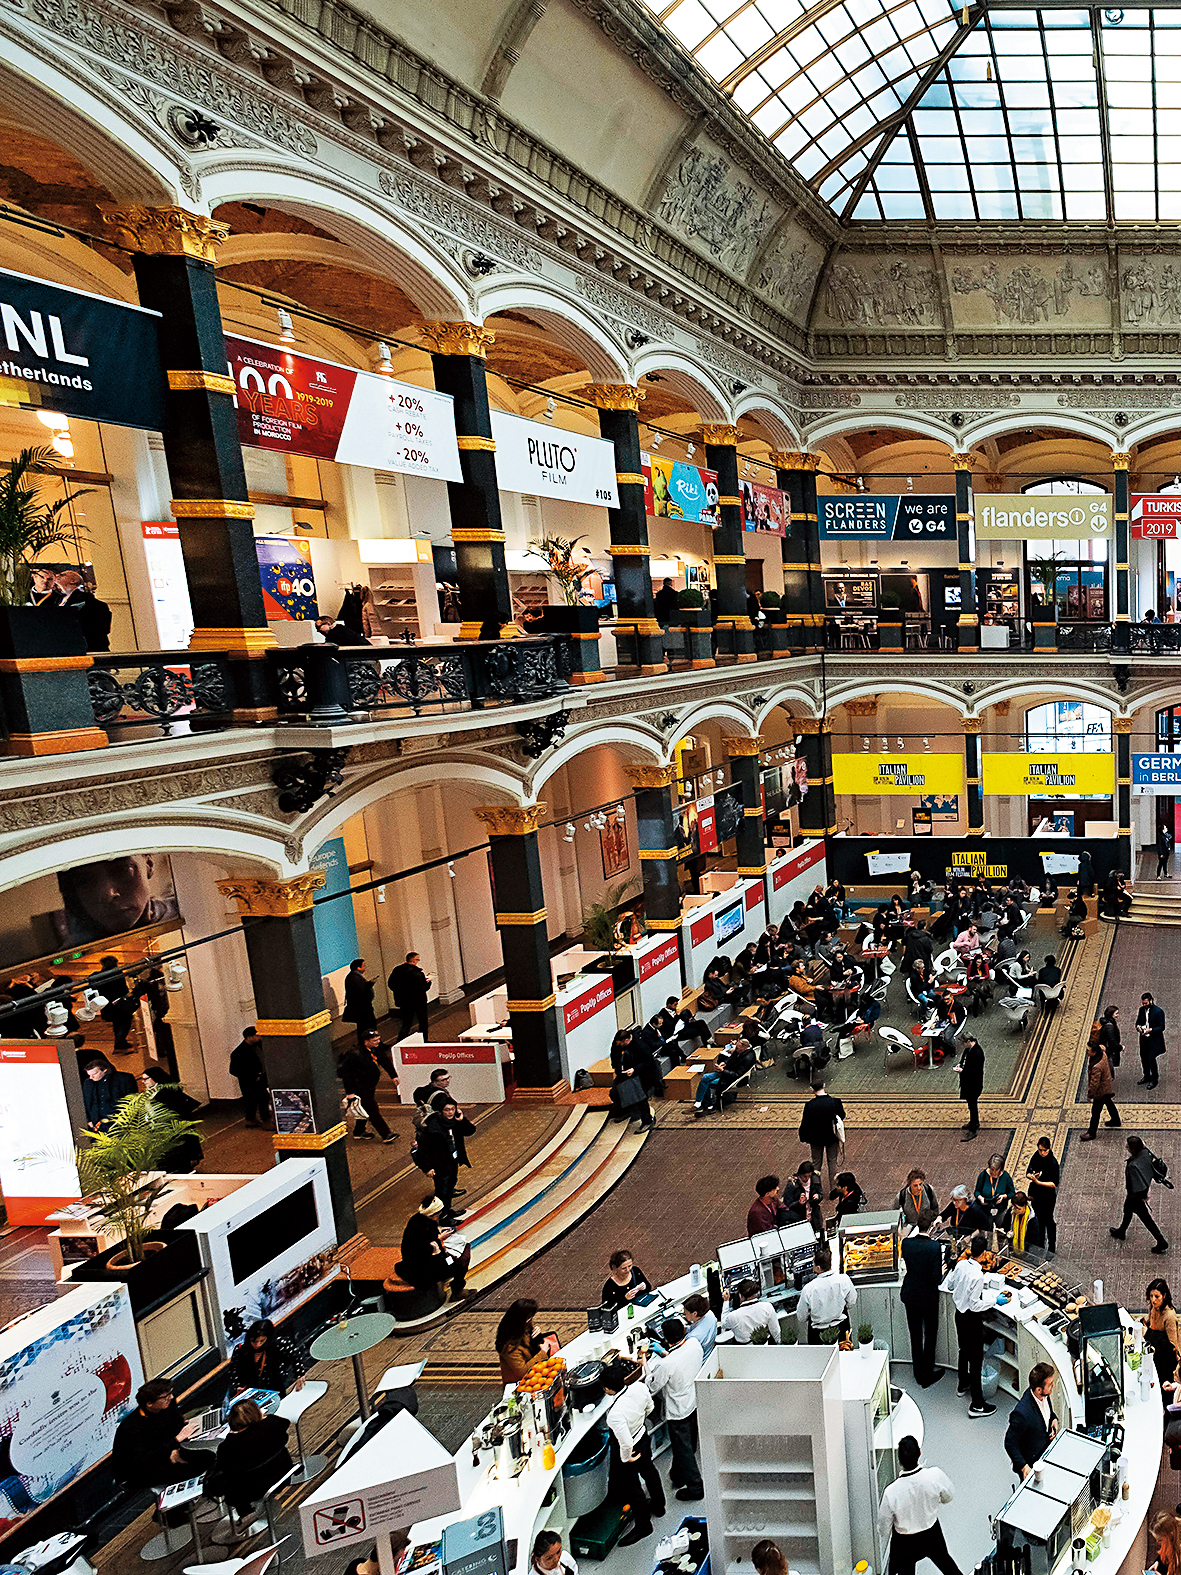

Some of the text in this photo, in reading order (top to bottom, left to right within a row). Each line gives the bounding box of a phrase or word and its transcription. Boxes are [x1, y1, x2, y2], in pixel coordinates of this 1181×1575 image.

[0, 303, 90, 367] NL
[243, 357, 285, 373] CELEBRATION
[285, 366, 294, 375] OF
[0, 361, 93, 391] therlands
[296, 391, 334, 408] 1919-2019
[398, 394, 424, 413] 20%
[242, 388, 319, 426] YEARS
[252, 413, 303, 430] OF FOREIGN FILM
[252, 421, 292, 434] PRODUCTION
[261, 430, 292, 441] MOROCCO
[404, 422, 424, 438] 0%
[403, 447, 429, 464] 20%
[527, 437, 576, 473] PLUTO
[387, 459, 406, 468] VALUE
[541, 471, 567, 485] FILM
[676, 479, 699, 495] Riki
[595, 489, 612, 501] #105
[825, 502, 886, 518] SCREEN
[904, 504, 948, 514] we are
[1089, 502, 1108, 513] G4
[981, 506, 1069, 528] flanders
[825, 520, 887, 529] FLANDERS
[926, 520, 946, 532] G4
[1146, 523, 1174, 535] 2019
[280, 578, 315, 597] ifp 40
[879, 764, 906, 775] ITALIAN
[1029, 764, 1057, 775] ITALIAN
[895, 775, 925, 785] PAVILION
[1045, 775, 1075, 785] PAVILION
[1139, 773, 1149, 781] in
[952, 853, 985, 865] ITALIAN
[971, 865, 1007, 877] PAVILION
[652, 944, 678, 968] PopUp Offices
[580, 986, 613, 1015] PopUp Offices
